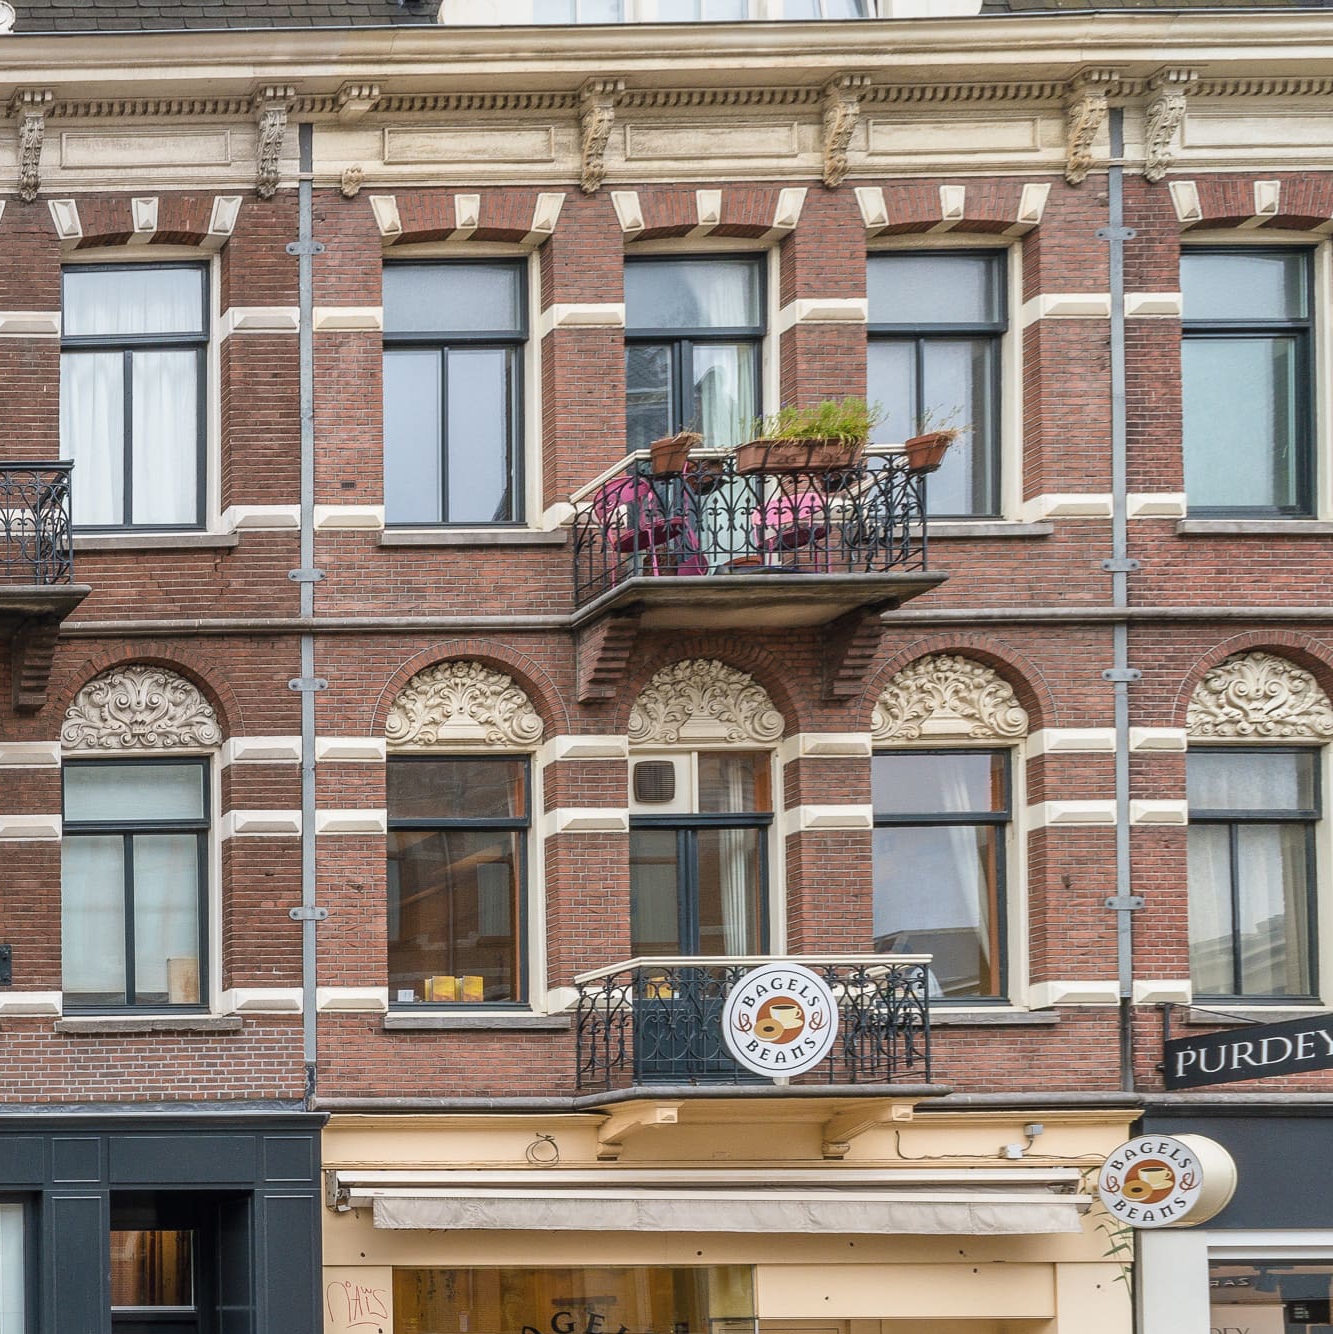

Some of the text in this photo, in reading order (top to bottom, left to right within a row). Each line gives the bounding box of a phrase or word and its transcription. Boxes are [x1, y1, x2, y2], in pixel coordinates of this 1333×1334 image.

[741, 977, 820, 1008] BAGELS
[745, 1037, 817, 1063] BEANS
[1109, 1142, 1192, 1171] BAGELS
[1113, 1197, 1187, 1222] BEANS
